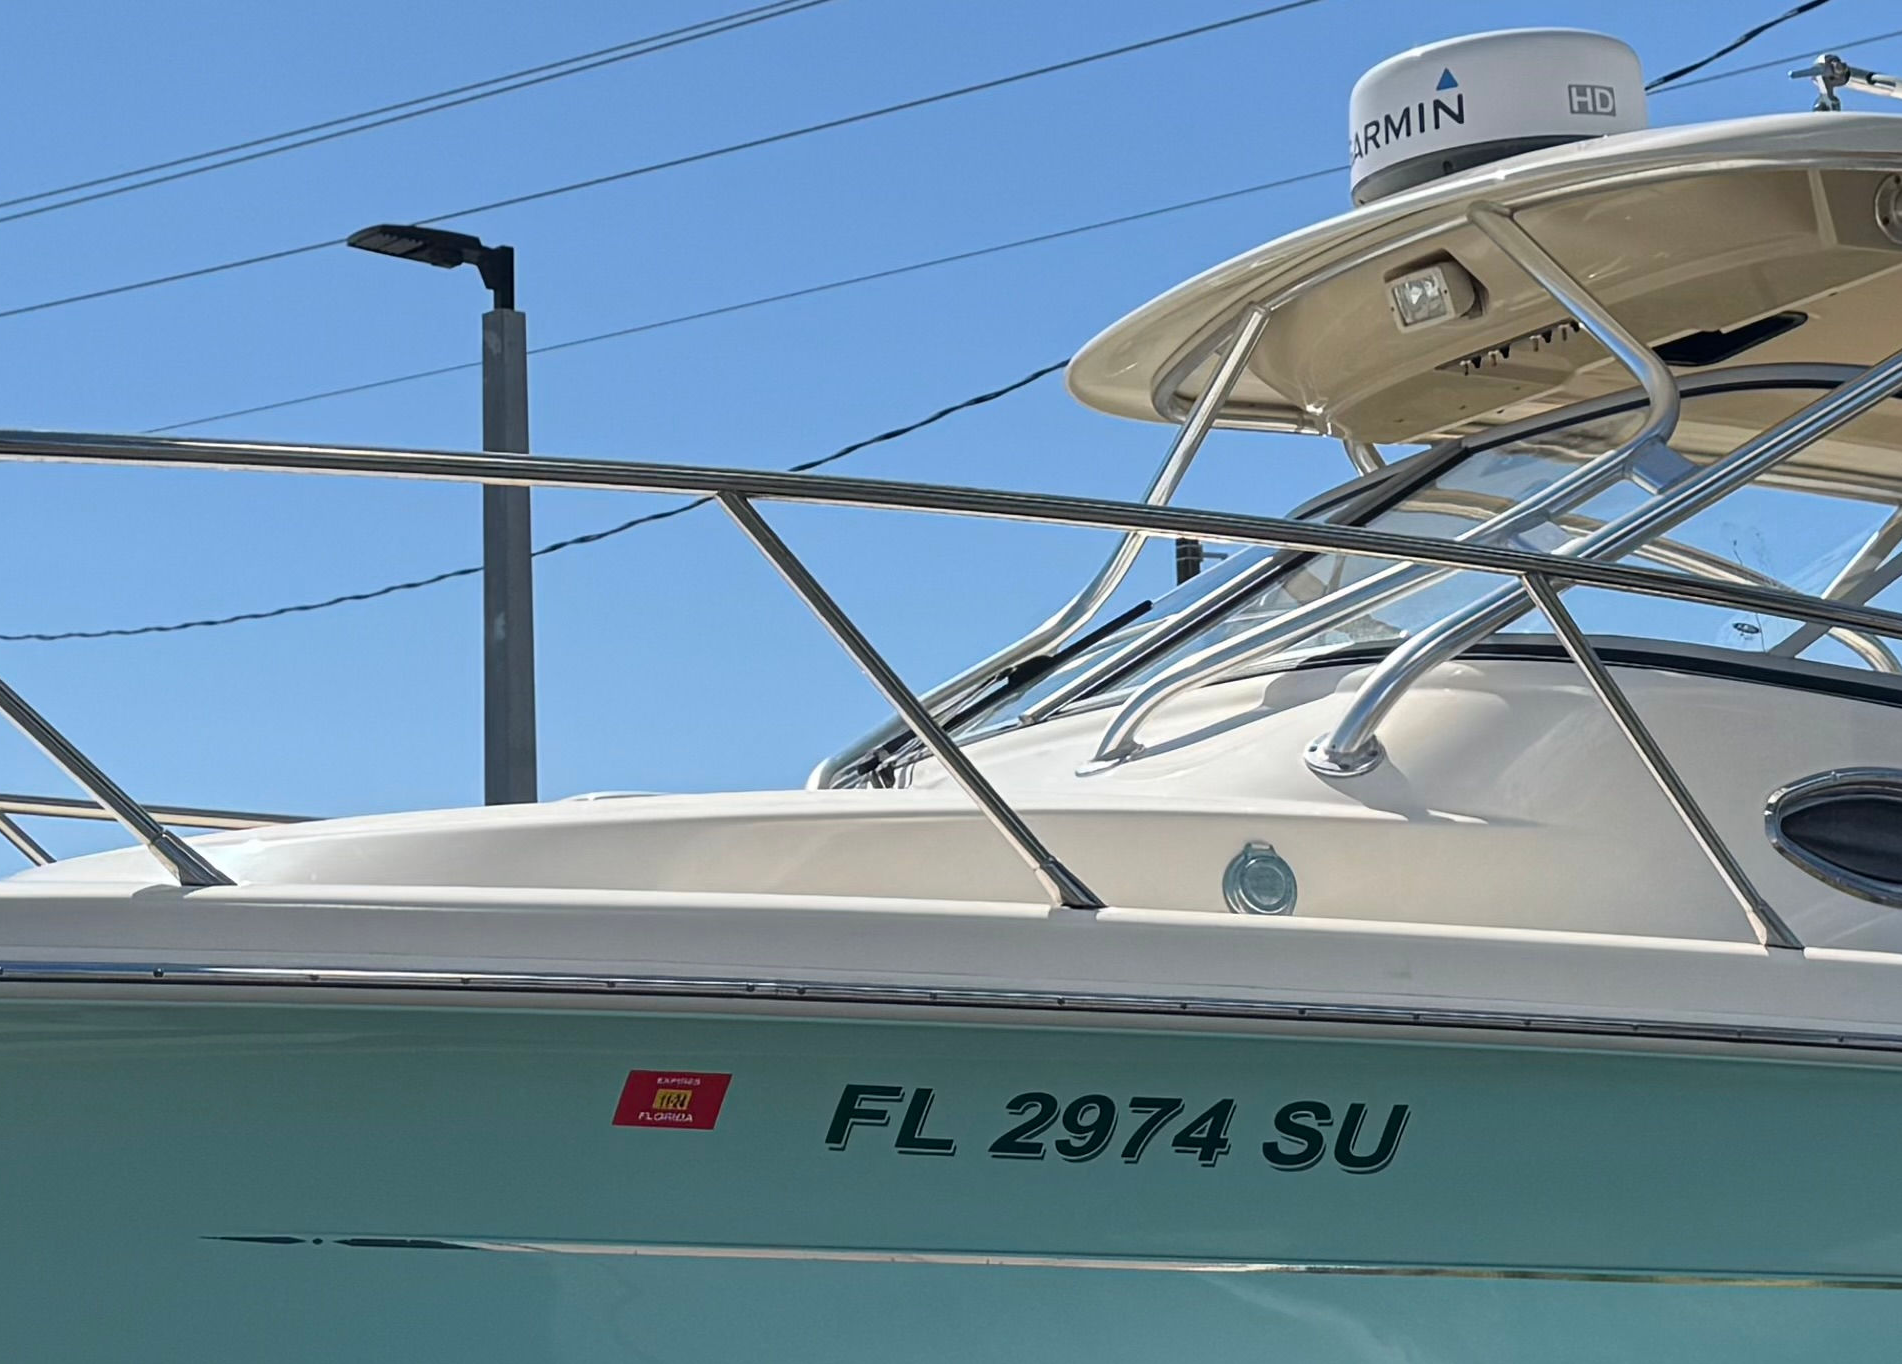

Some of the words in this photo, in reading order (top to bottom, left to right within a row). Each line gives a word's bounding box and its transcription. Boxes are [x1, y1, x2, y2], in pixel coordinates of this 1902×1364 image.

[1571, 86, 1615, 114] HD
[1349, 93, 1465, 166] ARMIN
[638, 1111, 693, 1122] FLORIDA
[825, 1084, 956, 1156] FL
[988, 1092, 1237, 1168] 2974
[1262, 1101, 1410, 1175] SU
